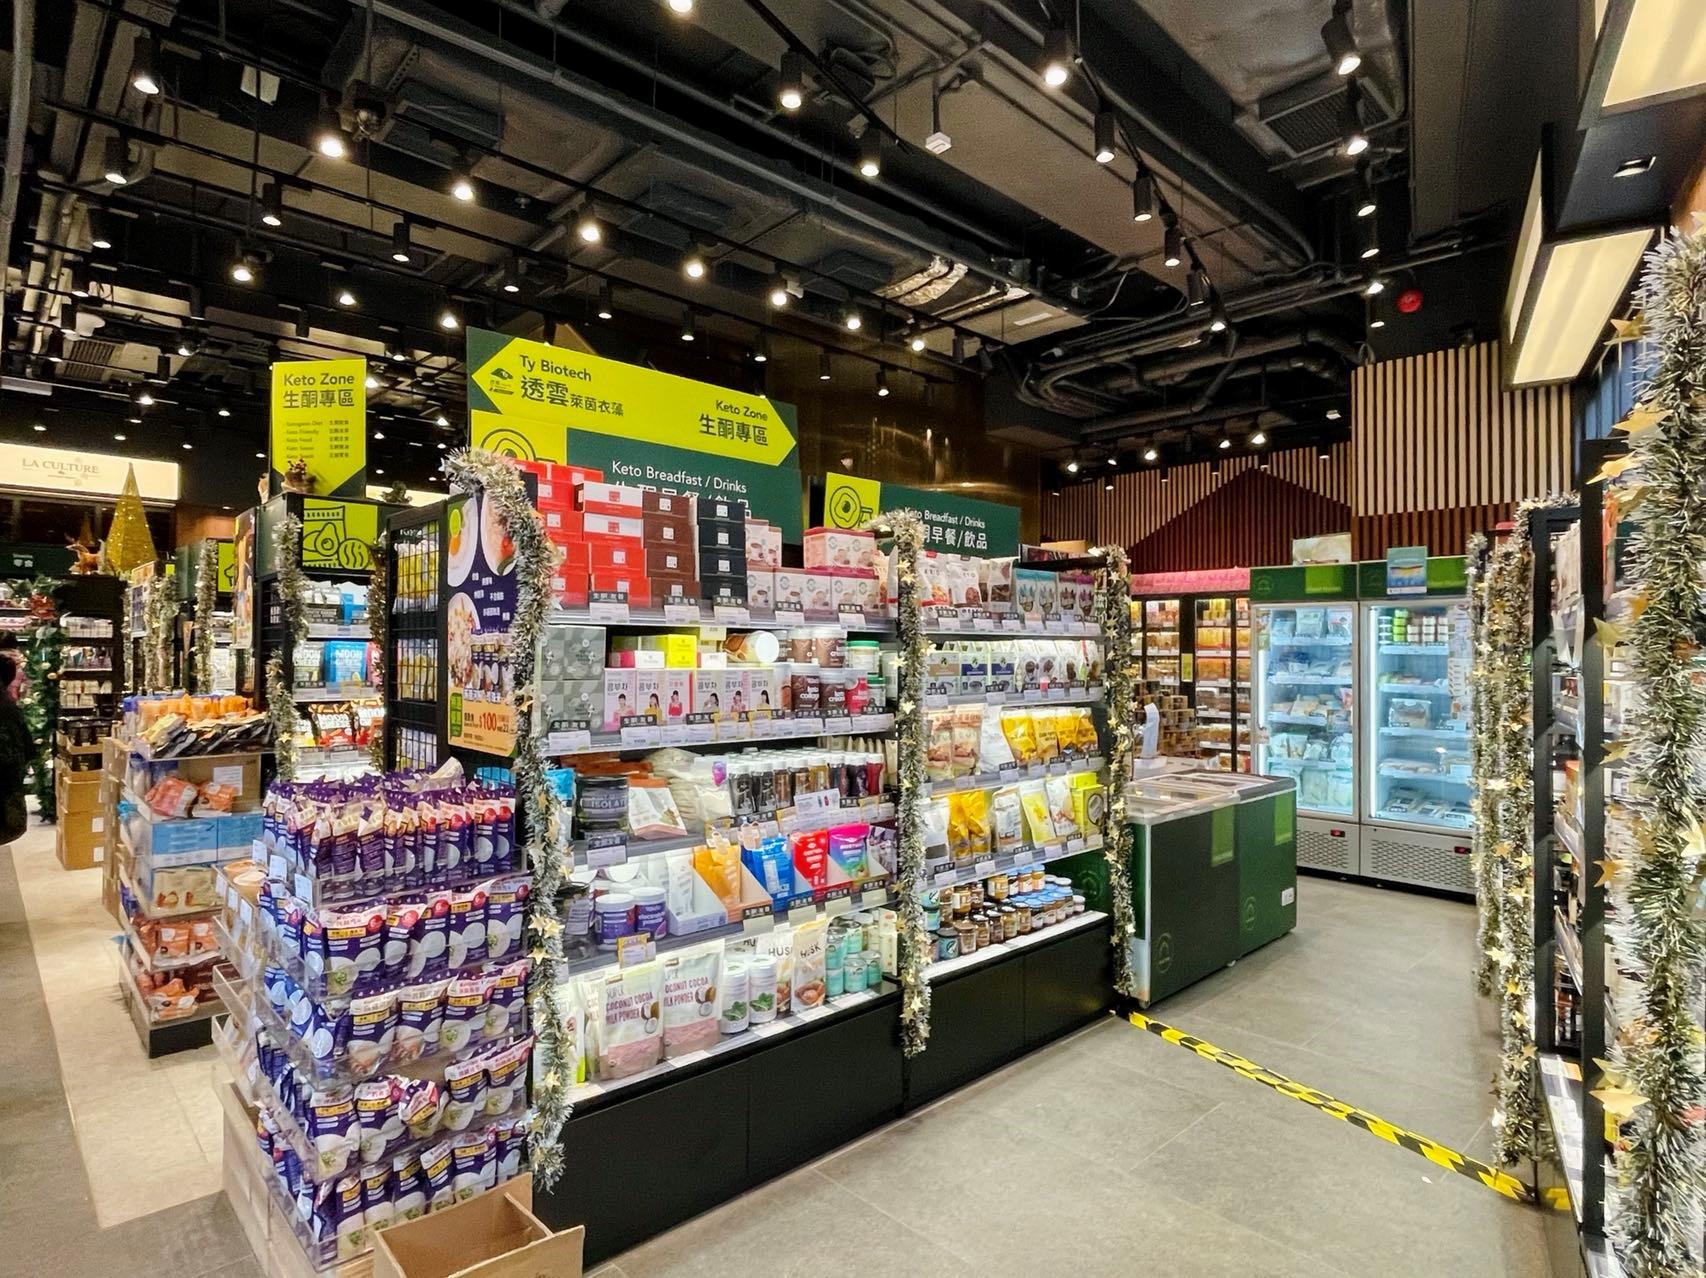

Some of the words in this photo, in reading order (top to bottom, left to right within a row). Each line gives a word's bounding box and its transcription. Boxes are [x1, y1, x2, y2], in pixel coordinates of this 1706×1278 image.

[520, 355, 535, 372] Ty
[541, 359, 591, 381] Biotech
[283, 374, 315, 386] Keto
[320, 373, 354, 385] Zone
[283, 389, 354, 408] 生酮專區
[716, 400, 740, 415] Keto
[744, 406, 768, 421] Zone
[699, 413, 768, 446] 生酮專區
[22, 458, 40, 468] LA
[42, 460, 100, 474] CULTURE
[612, 460, 641, 477] Keto
[646, 466, 702, 487] Breadfast
[714, 477, 747, 493] Drinks
[924, 510, 958, 524] Breadfast
[964, 516, 986, 528] Drinks
[800, 942, 821, 958] HSK
[688, 976, 709, 988] COCOA
[606, 997, 633, 1012] COCONUT
[634, 991, 654, 1004] COCOA
[674, 991, 694, 1004] POWDER
[619, 1008, 640, 1021] POWDER
